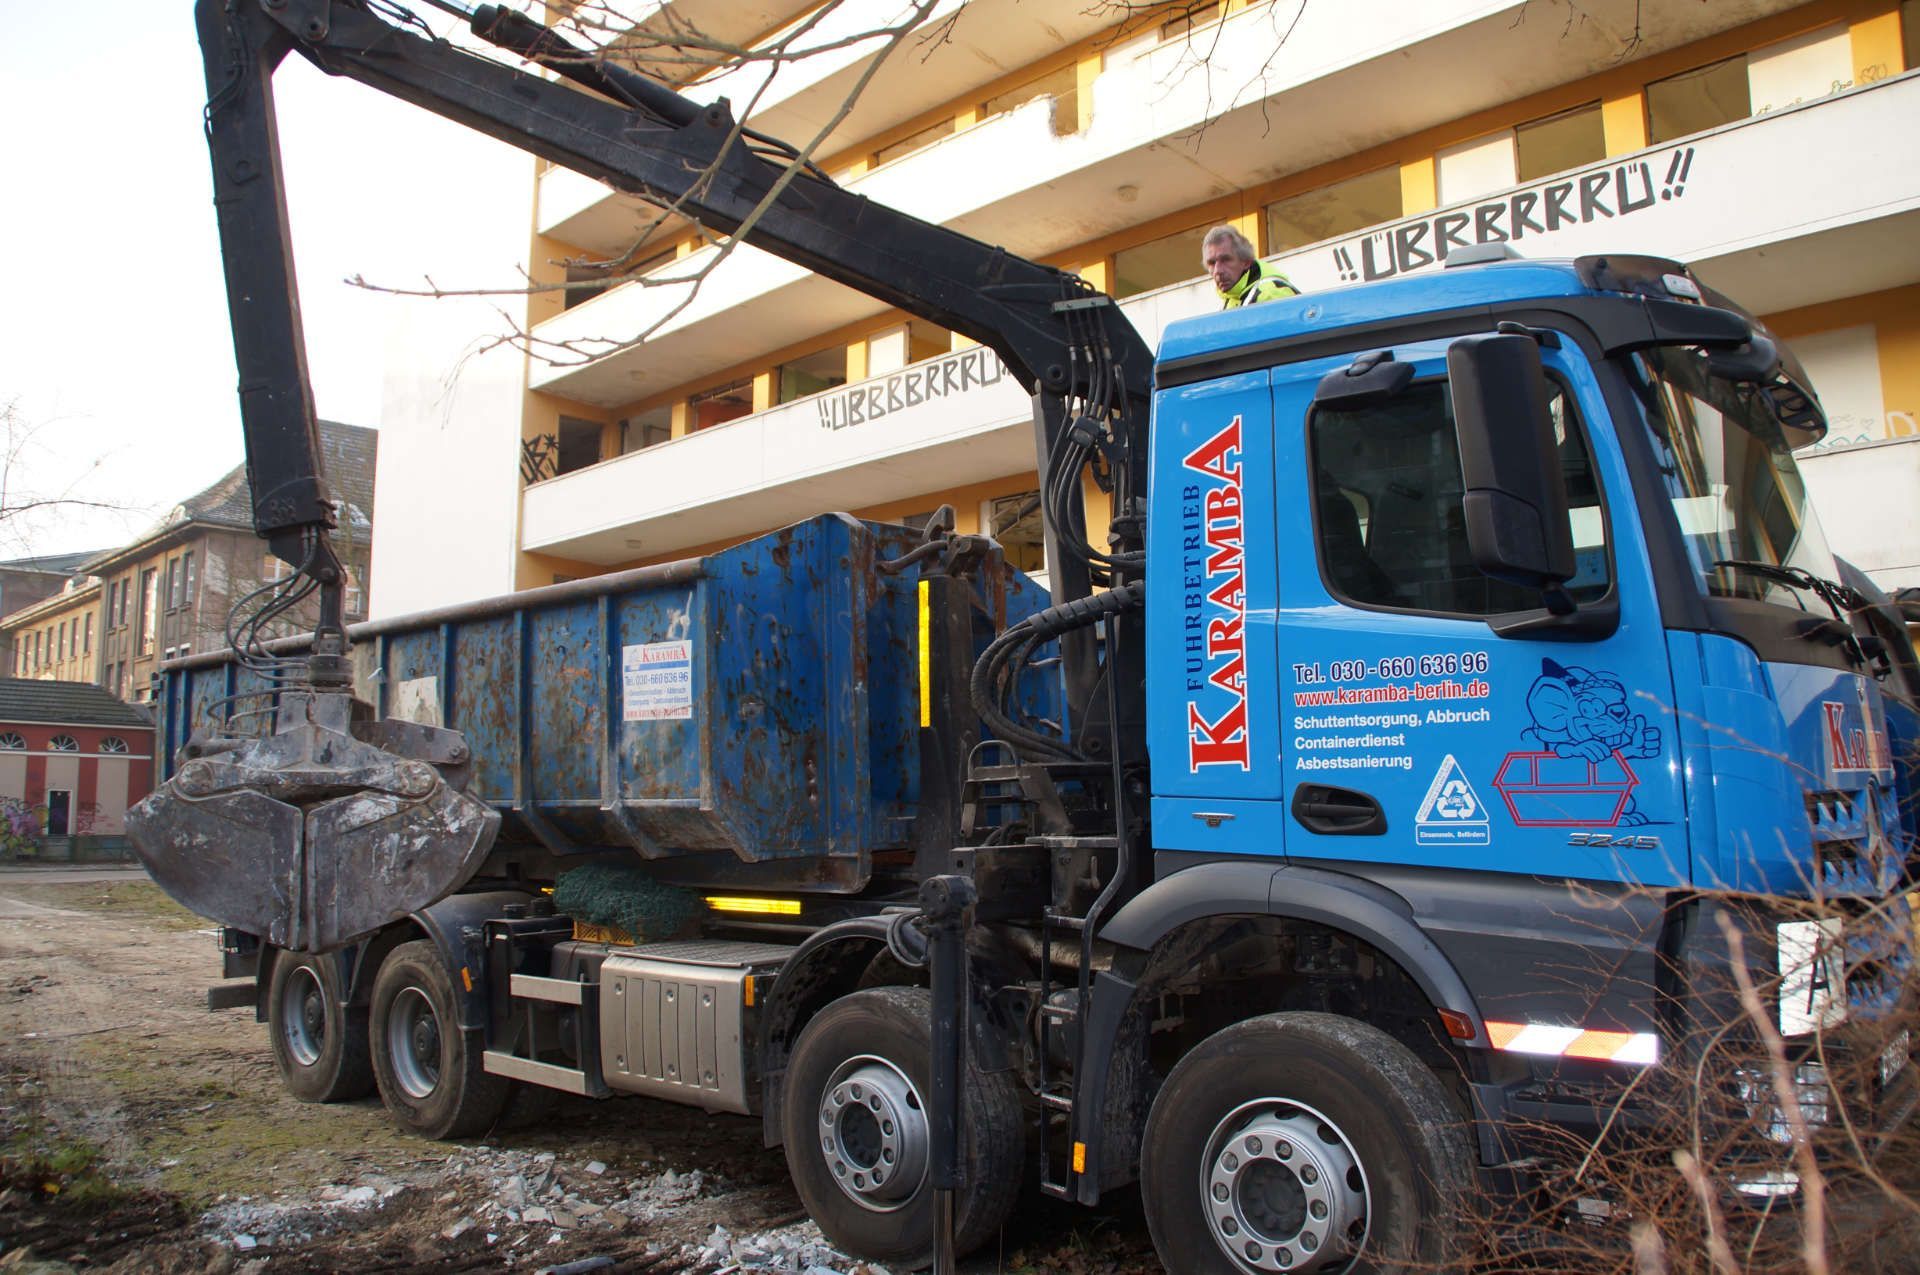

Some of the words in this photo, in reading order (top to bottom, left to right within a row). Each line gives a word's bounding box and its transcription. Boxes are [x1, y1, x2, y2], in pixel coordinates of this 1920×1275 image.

[817, 347, 1010, 431] !!ÜBBBBRRRÜ
[1182, 414, 1250, 773] KARAMBA
[1184, 485, 1204, 692] FUHRBETRIEB
[1293, 663, 1326, 684] Tel.
[1419, 652, 1457, 677] 636
[1461, 650, 1488, 674] 96
[1294, 678, 1490, 707] www.karamba-berlin.de
[1294, 711, 1422, 729] Schuttentsorgung,
[1426, 708, 1490, 724] Abbruch
[1295, 733, 1405, 750] Containerdienst
[1296, 755, 1412, 770] Asbestsanierung
[1568, 832, 1658, 850] 3245
[1807, 935, 1833, 1015] A
